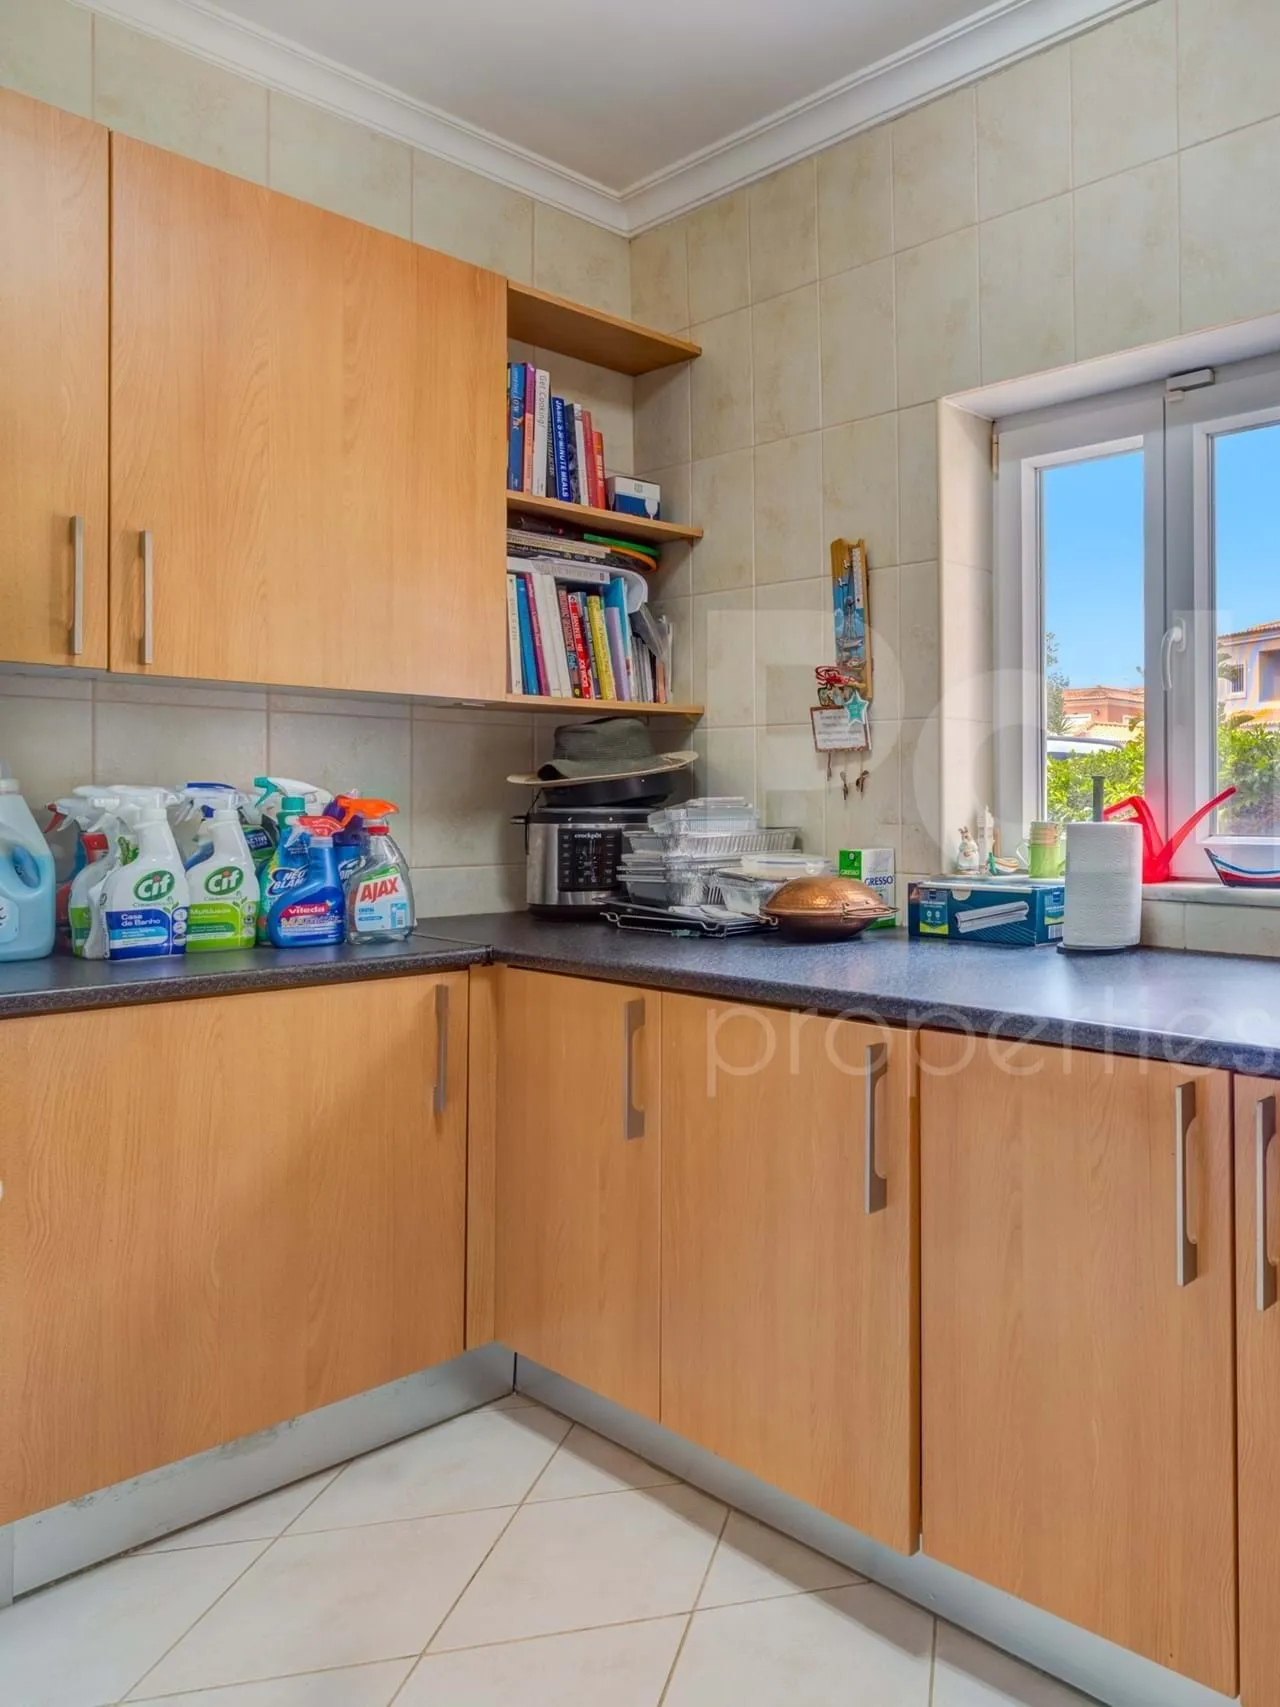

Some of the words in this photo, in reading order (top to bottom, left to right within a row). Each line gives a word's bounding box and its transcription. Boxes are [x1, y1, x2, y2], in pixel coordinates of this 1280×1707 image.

[561, 472, 570, 497] MEALS
[137, 871, 173, 898] Cif
[206, 867, 241, 894] Cif
[864, 875, 894, 886] GRESSO
[360, 878, 399, 904] AJAX
[120, 913, 143, 921] Casa
[288, 904, 326, 915] vileda
[120, 920, 133, 928] de
[134, 918, 161, 926] Banho
